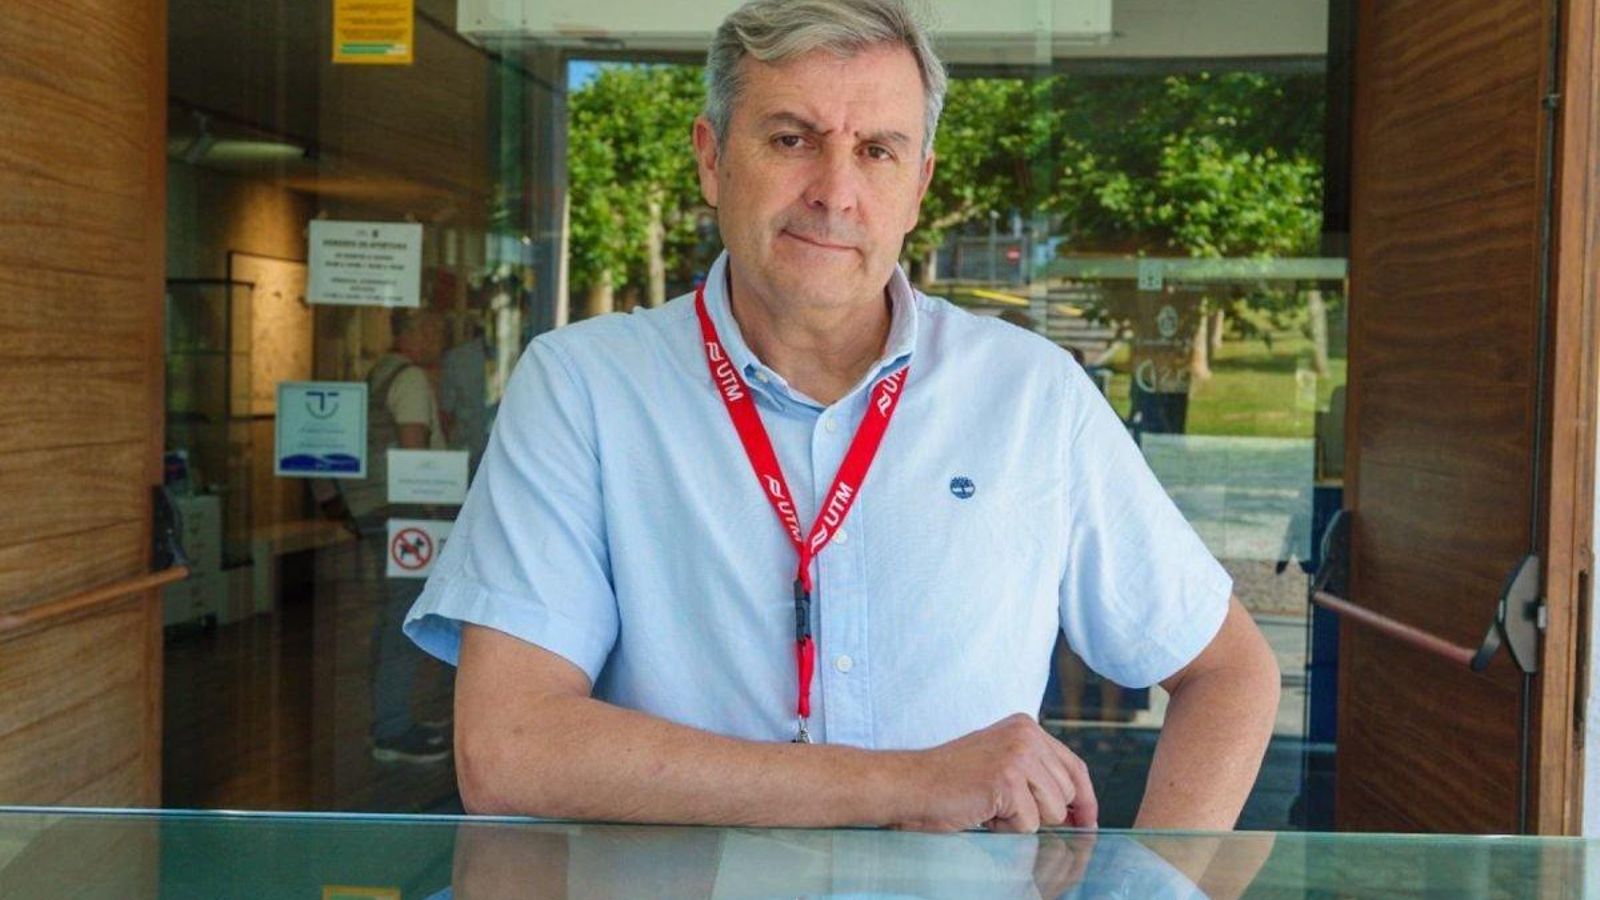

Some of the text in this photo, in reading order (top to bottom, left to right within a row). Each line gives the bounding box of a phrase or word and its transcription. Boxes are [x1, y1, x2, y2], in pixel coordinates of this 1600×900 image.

[717, 361, 744, 401] UTM
[778, 501, 801, 542] UTM
[824, 481, 853, 527] UTM
